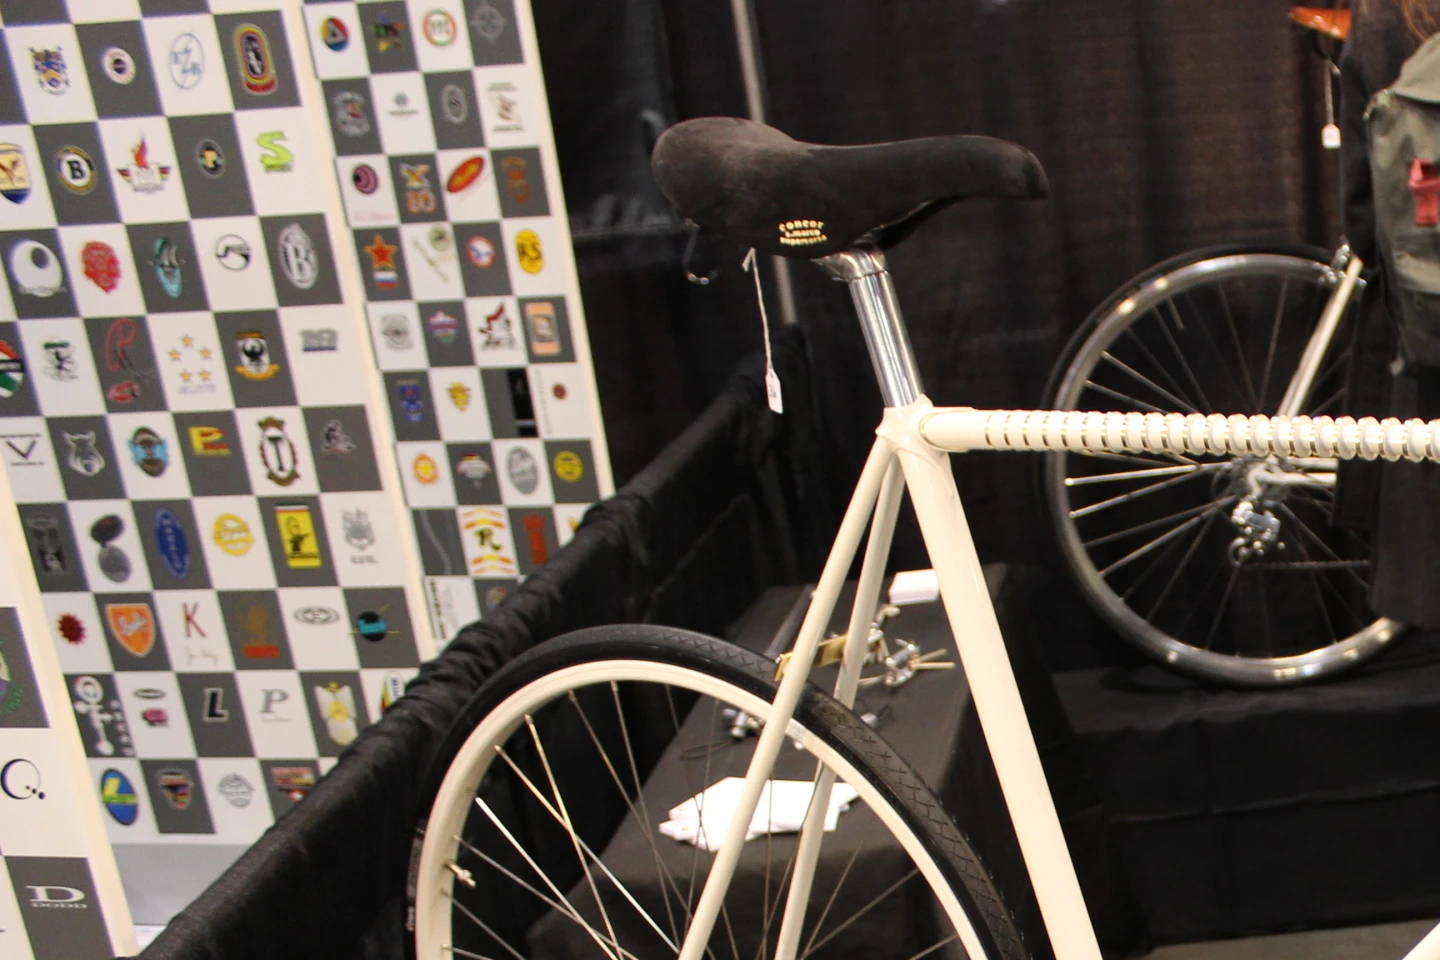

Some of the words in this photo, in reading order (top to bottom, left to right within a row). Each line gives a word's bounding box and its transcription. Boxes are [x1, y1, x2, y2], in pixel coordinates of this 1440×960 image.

[67, 160, 85, 179] B
[182, 602, 206, 638] K
[203, 687, 229, 722] L
[258, 688, 290, 714] P
[25, 885, 85, 902] D
